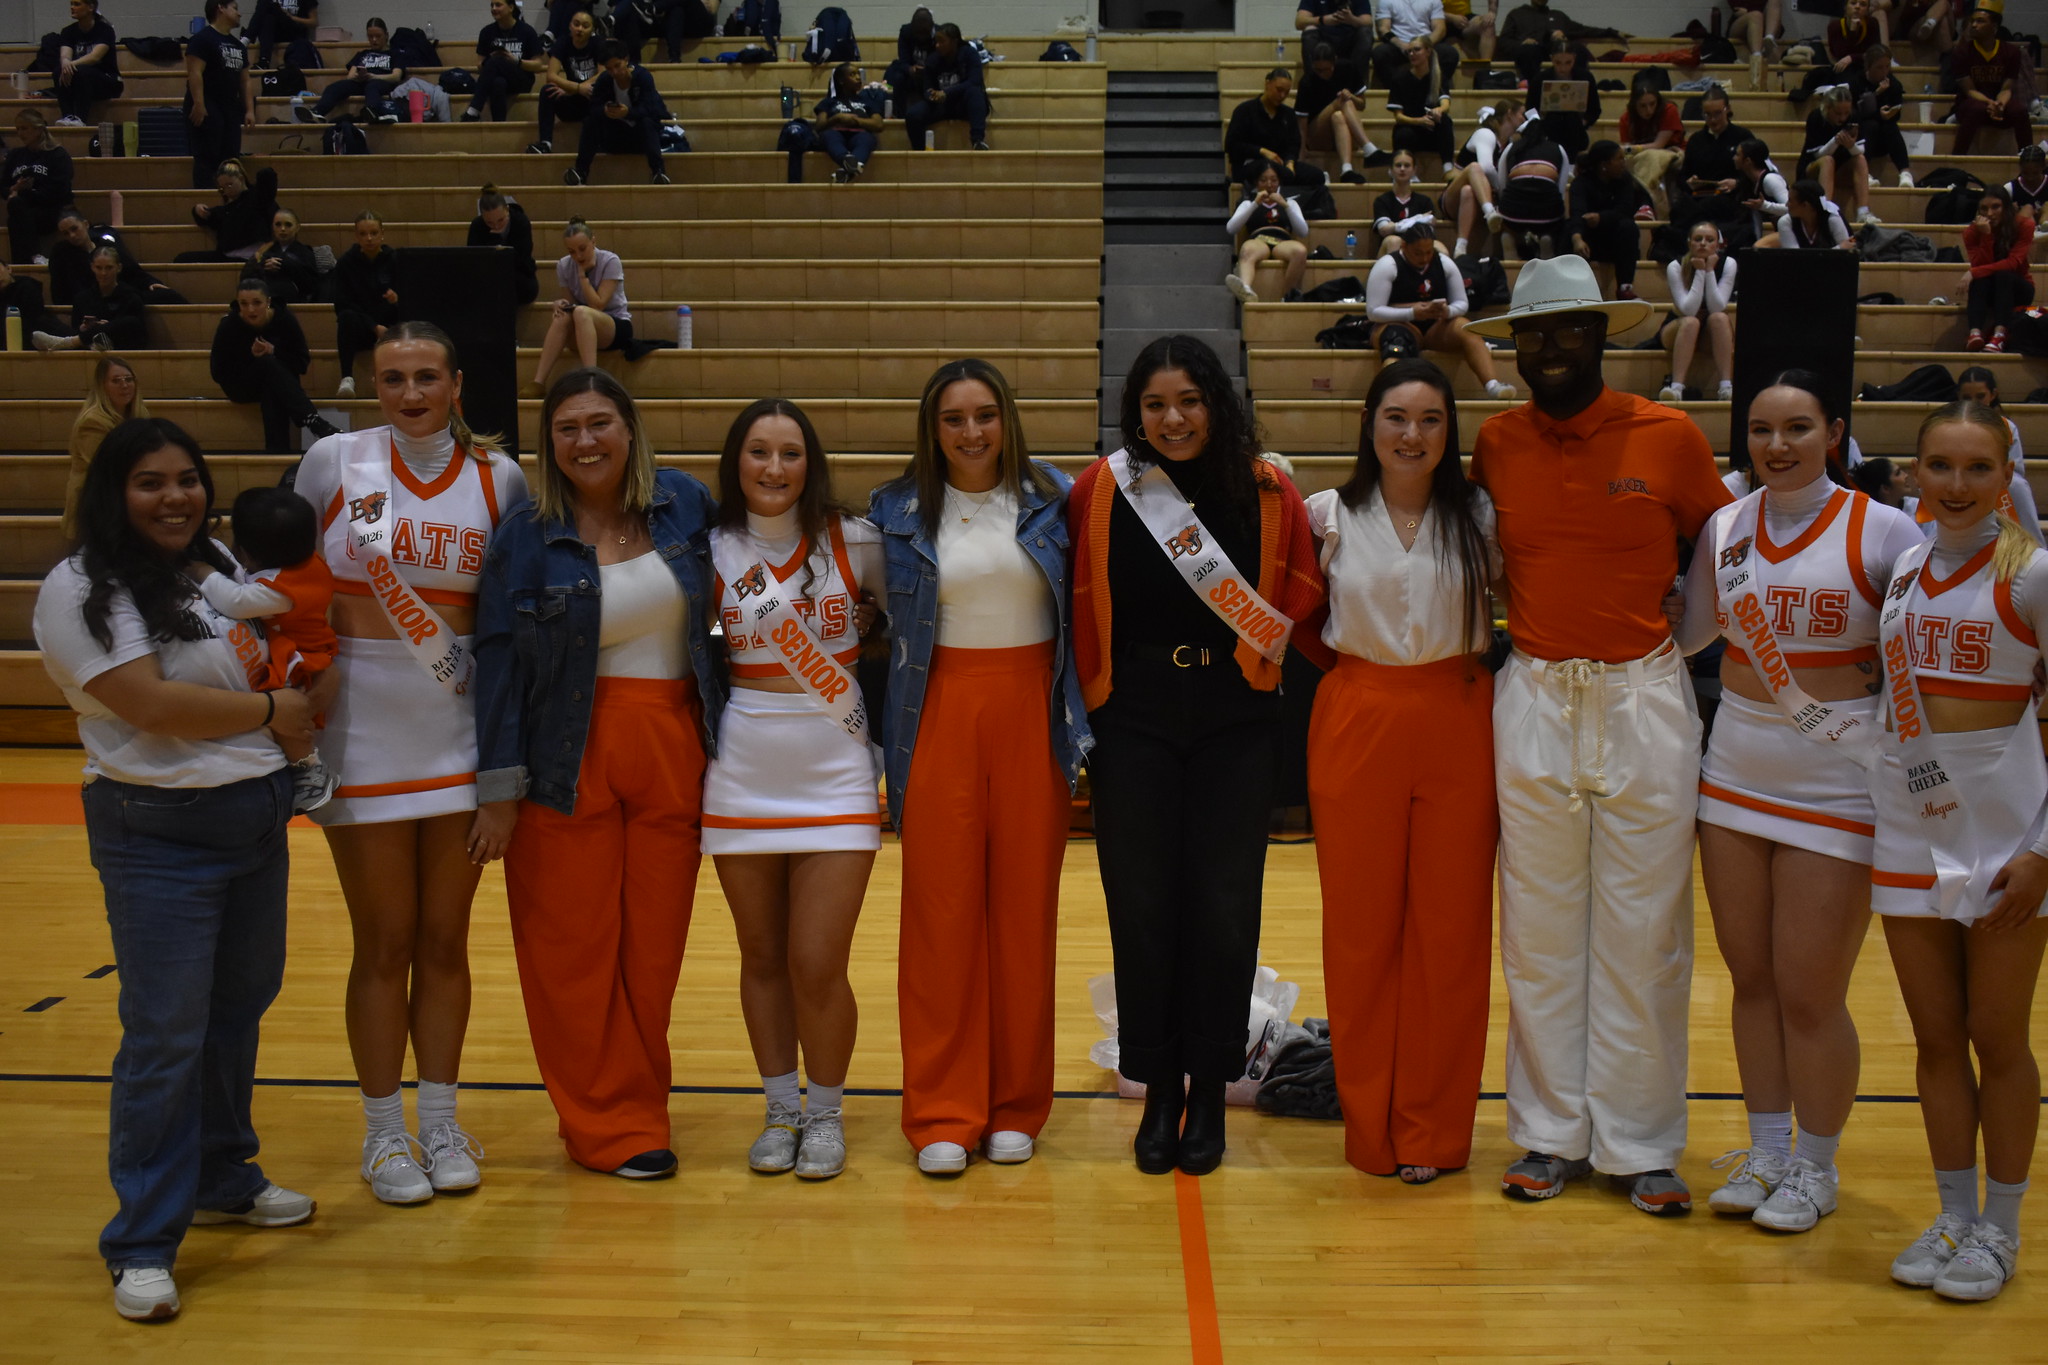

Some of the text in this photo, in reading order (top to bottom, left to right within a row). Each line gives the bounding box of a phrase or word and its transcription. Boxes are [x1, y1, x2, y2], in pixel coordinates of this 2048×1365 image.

[1607, 477, 1650, 496] BAKER
[346, 517, 487, 576] ATS
[358, 531, 383, 547] 2026
[1193, 557, 1219, 582] 2026
[1726, 571, 1749, 592] 2026
[367, 555, 438, 645] SENIOR
[755, 597, 780, 620] 2026
[1715, 585, 1850, 637] TS
[721, 593, 848, 650] CS
[1209, 578, 1286, 649] SENIOR
[1733, 593, 1789, 694] SENIOR
[1905, 612, 1994, 674] TS
[432, 643, 458, 672] BAKER
[772, 619, 849, 703] SENIOR
[1885, 634, 1921, 743] SENIOR
[848, 707, 866, 734] CHEE
[1792, 703, 1818, 723] BAKER
[1799, 707, 1833, 733] CHEER
[1826, 718, 1860, 741] Emily
[1907, 760, 1940, 779] BAKER
[1908, 771, 1950, 794] CHEER
[1921, 800, 1958, 820] Megan
